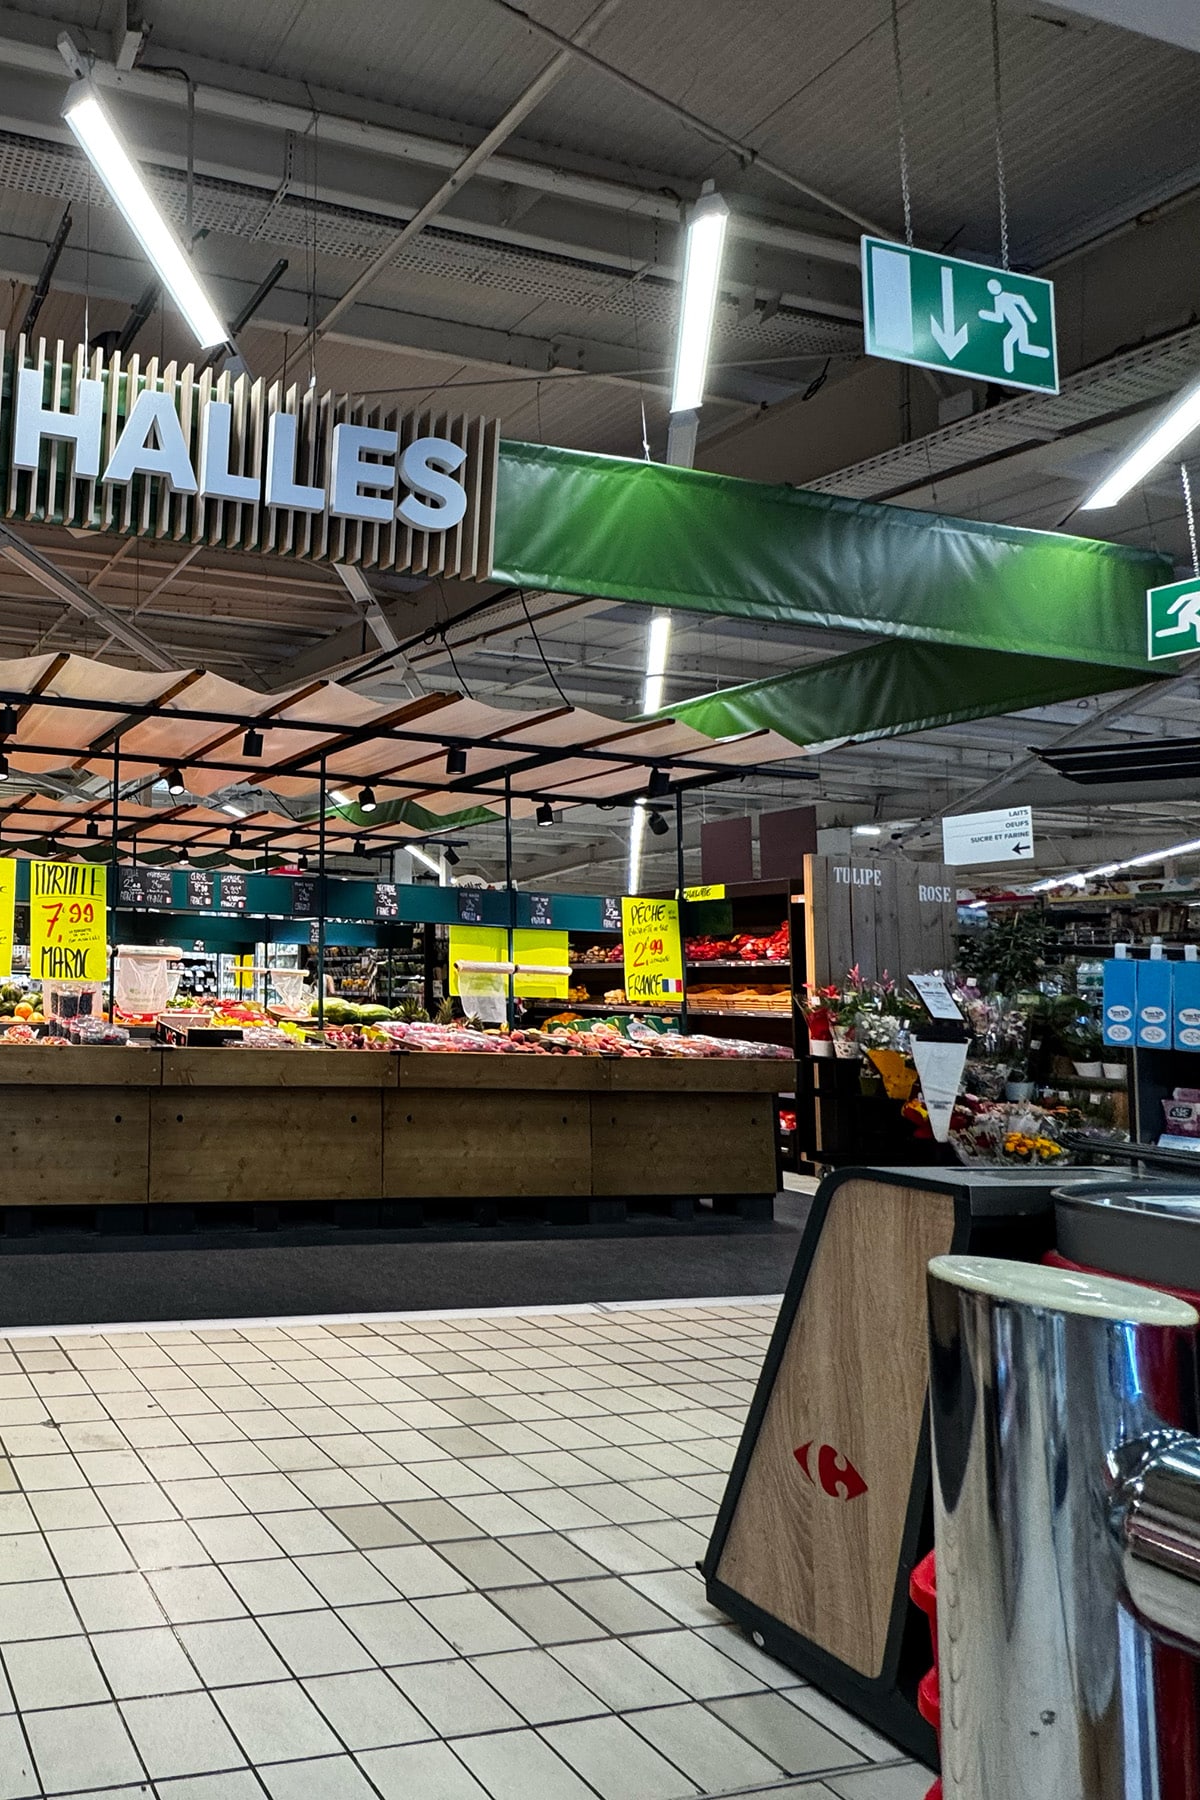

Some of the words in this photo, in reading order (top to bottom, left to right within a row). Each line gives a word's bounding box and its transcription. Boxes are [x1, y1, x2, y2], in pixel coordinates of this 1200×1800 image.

[14, 368, 468, 531] HALLES
[1005, 820, 1029, 828] OEUFS
[970, 835, 993, 843] SUCRE
[1004, 831, 1029, 839] FARINE
[35, 863, 103, 896] MYRTILLE
[833, 867, 882, 886] TULIPE
[918, 885, 951, 902] ROSE
[631, 902, 666, 926] PÊCHE
[41, 945, 91, 979] MAROC
[627, 974, 663, 996] FRANCE
